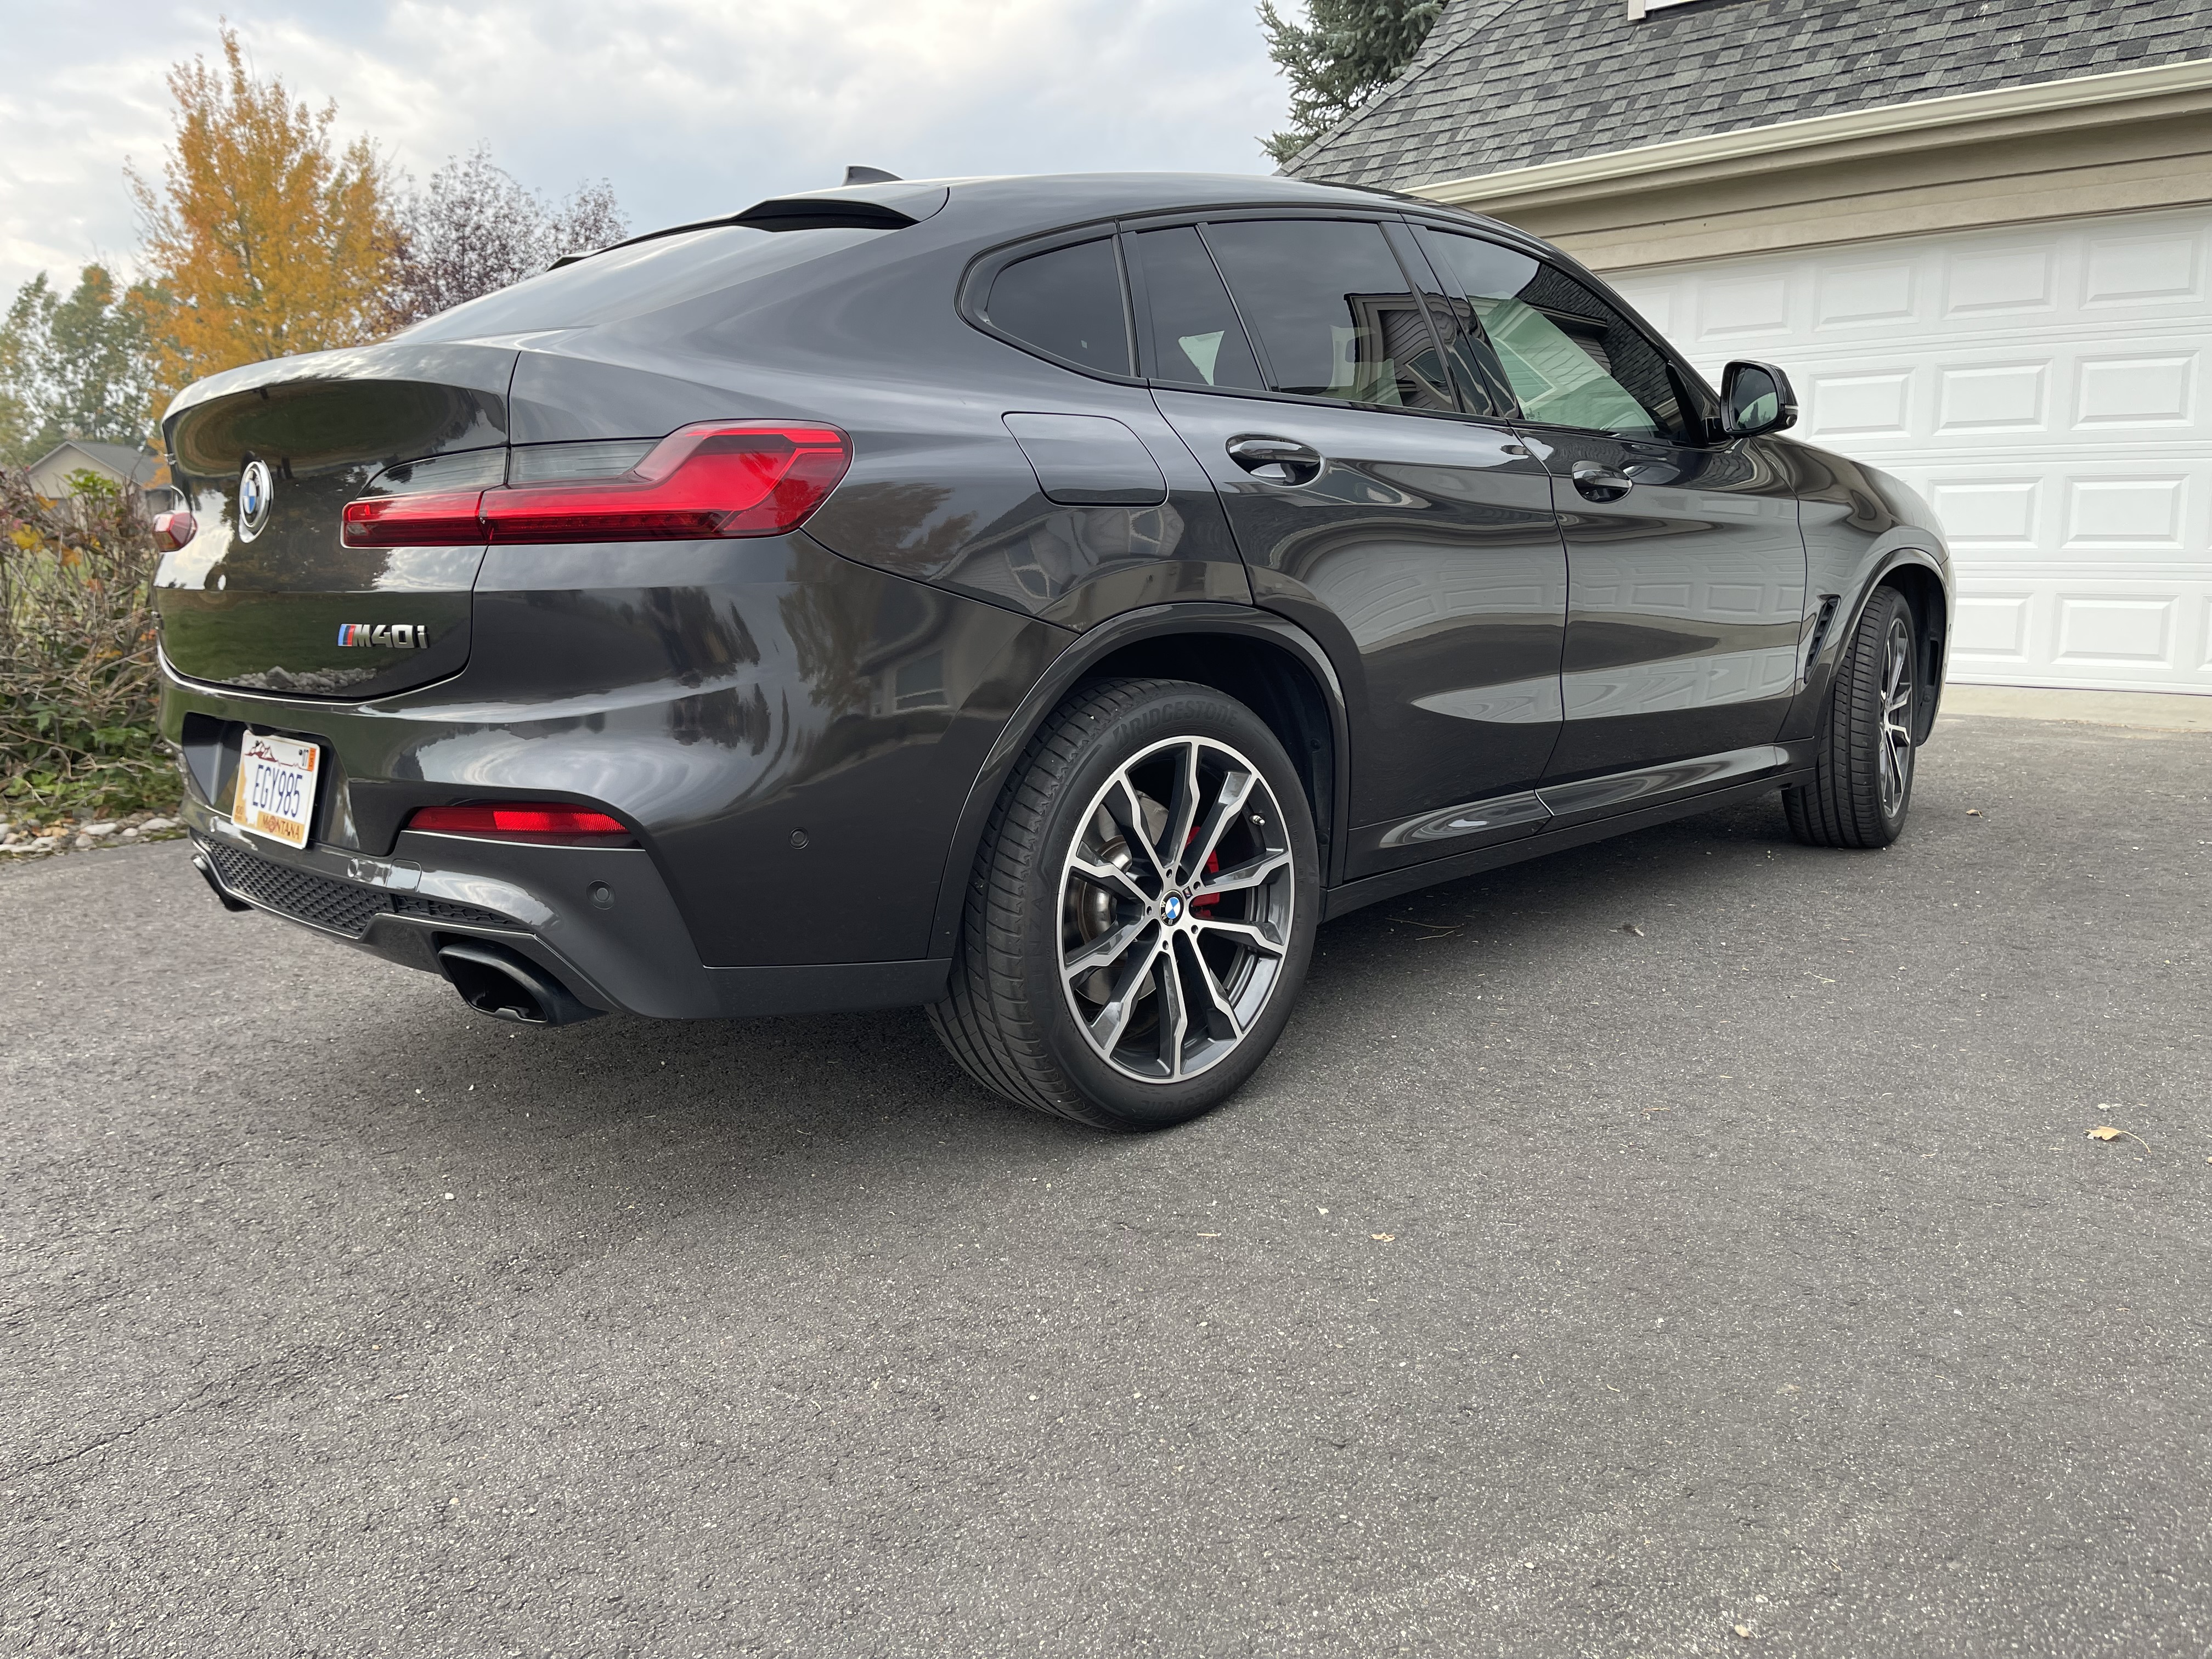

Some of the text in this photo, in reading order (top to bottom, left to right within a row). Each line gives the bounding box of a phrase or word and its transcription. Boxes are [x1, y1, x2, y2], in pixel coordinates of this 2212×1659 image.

[351, 624, 428, 649] M40i
[1113, 700, 1238, 748] BRIDGESTONE
[252, 764, 303, 817] EGY985
[262, 814, 300, 840] MONTANA
[1160, 900, 1173, 925] BMW
